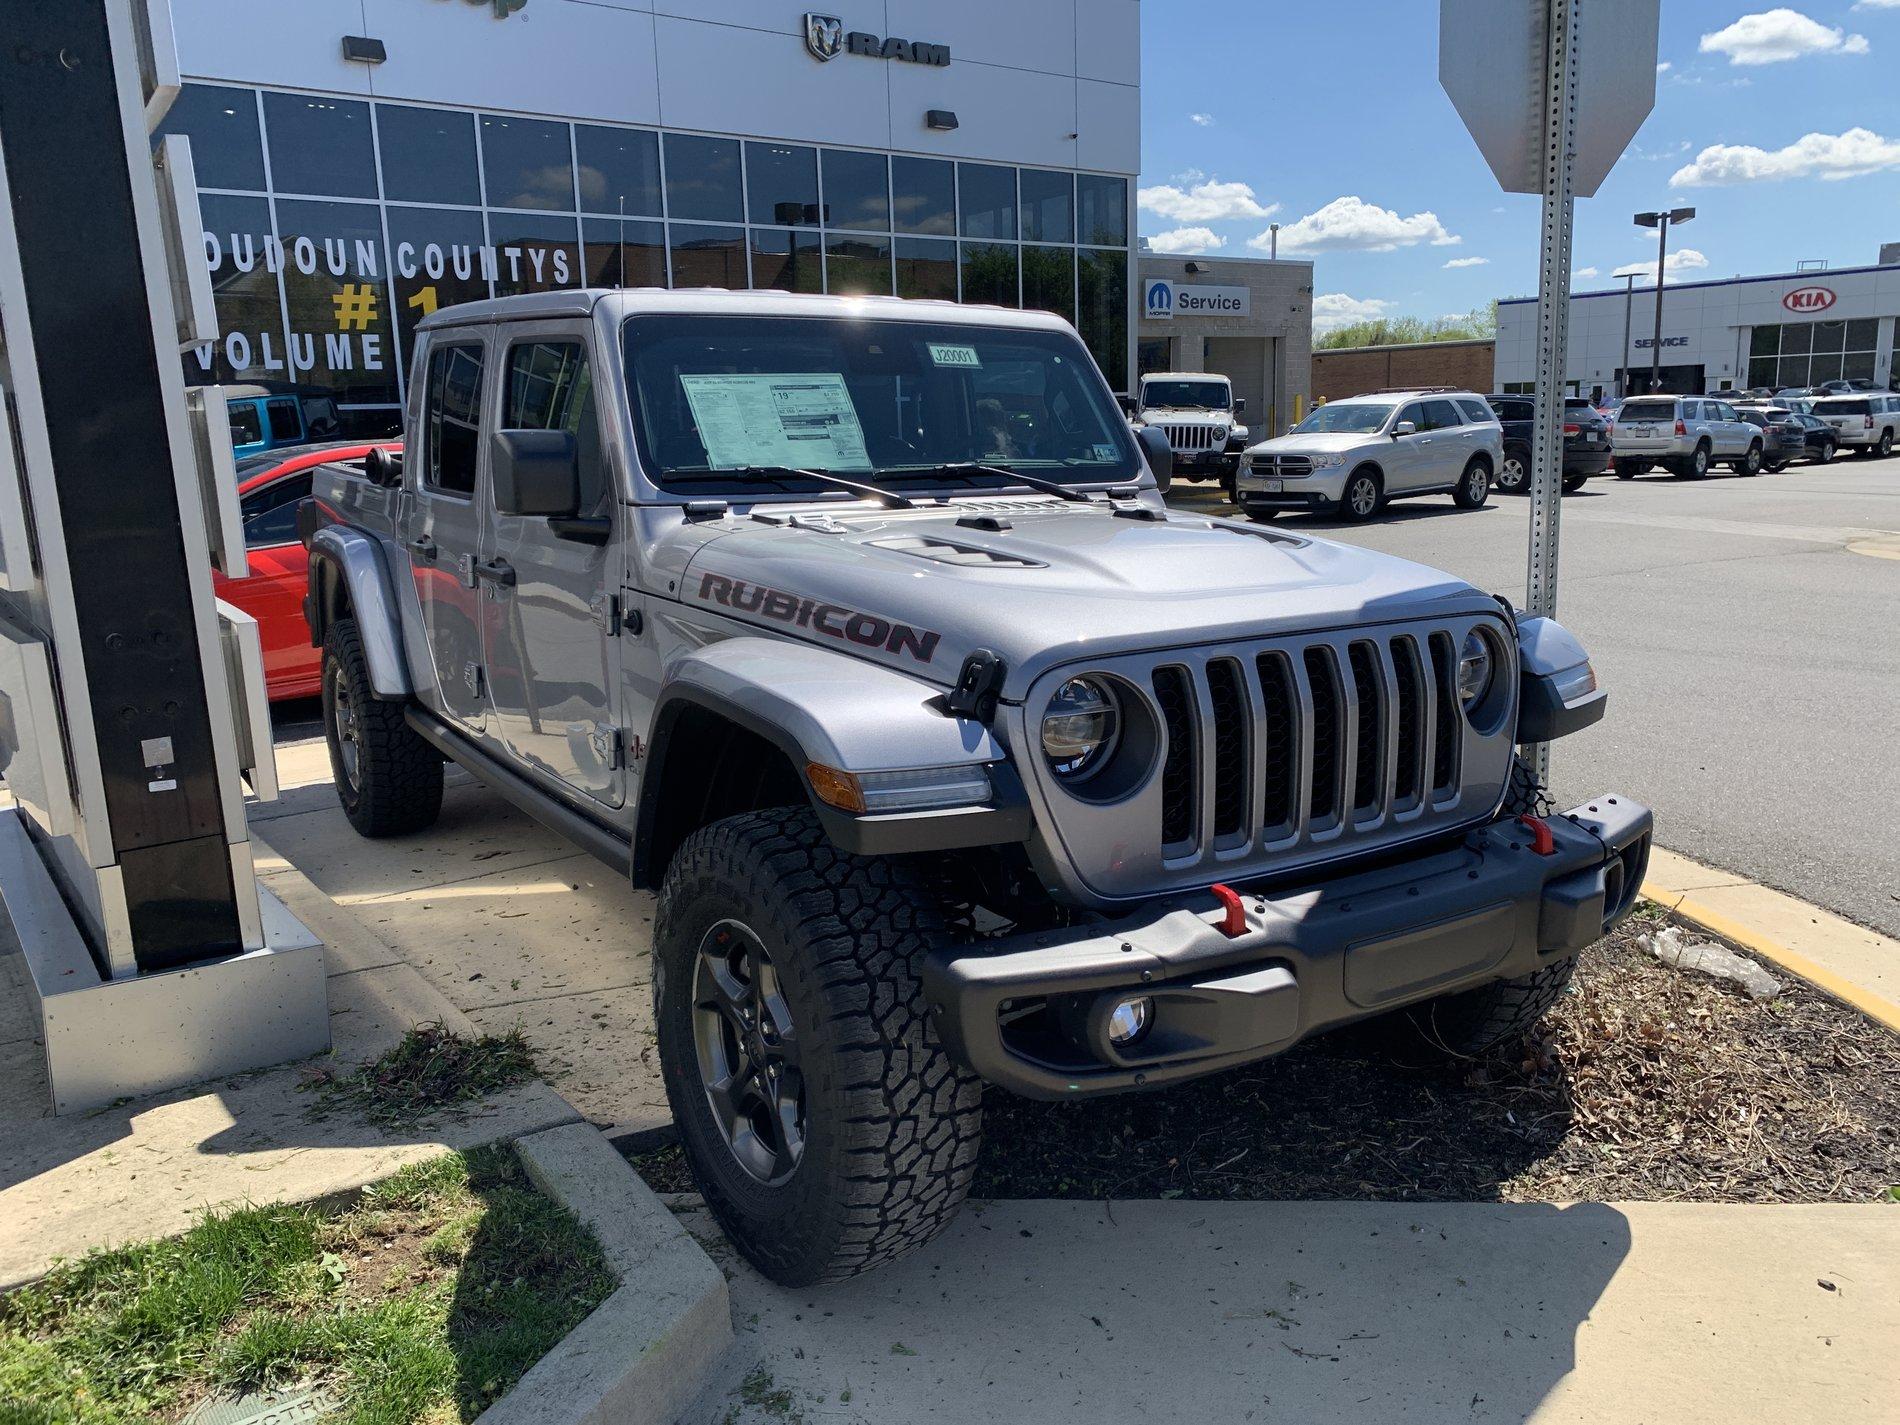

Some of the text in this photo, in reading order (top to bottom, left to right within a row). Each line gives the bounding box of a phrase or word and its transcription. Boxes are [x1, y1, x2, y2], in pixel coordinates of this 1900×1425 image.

[848, 31, 950, 66] RAM
[397, 241, 570, 284] COUNTYS
[1178, 292, 1241, 310] Service
[1791, 292, 1827, 308] KIA
[194, 331, 384, 371] VOLUME
[935, 348, 973, 363] J20001
[698, 572, 942, 664] RUBICON
